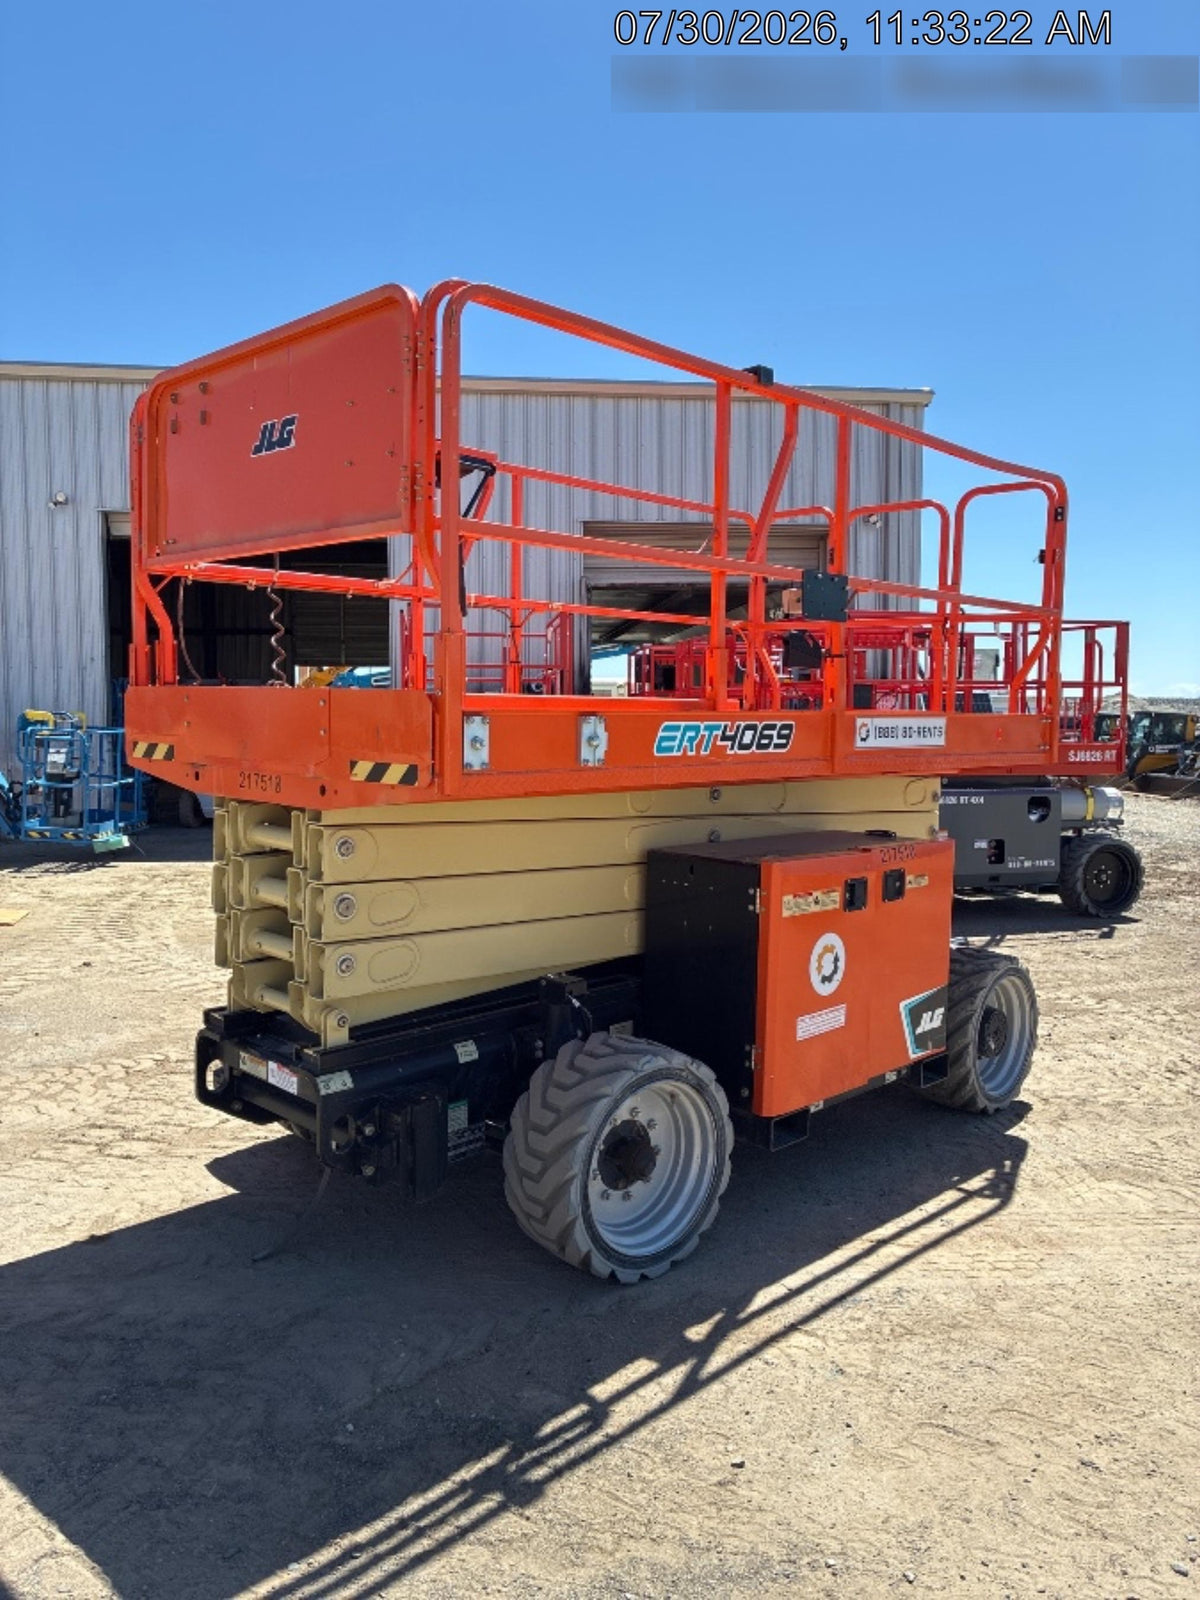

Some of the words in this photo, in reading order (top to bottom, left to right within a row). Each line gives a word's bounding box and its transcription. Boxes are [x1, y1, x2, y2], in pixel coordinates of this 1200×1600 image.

[251, 413, 299, 458] JLG
[653, 721, 796, 756] ERT4069
[239, 771, 282, 793] 217518
[915, 1006, 945, 1036] JLG
